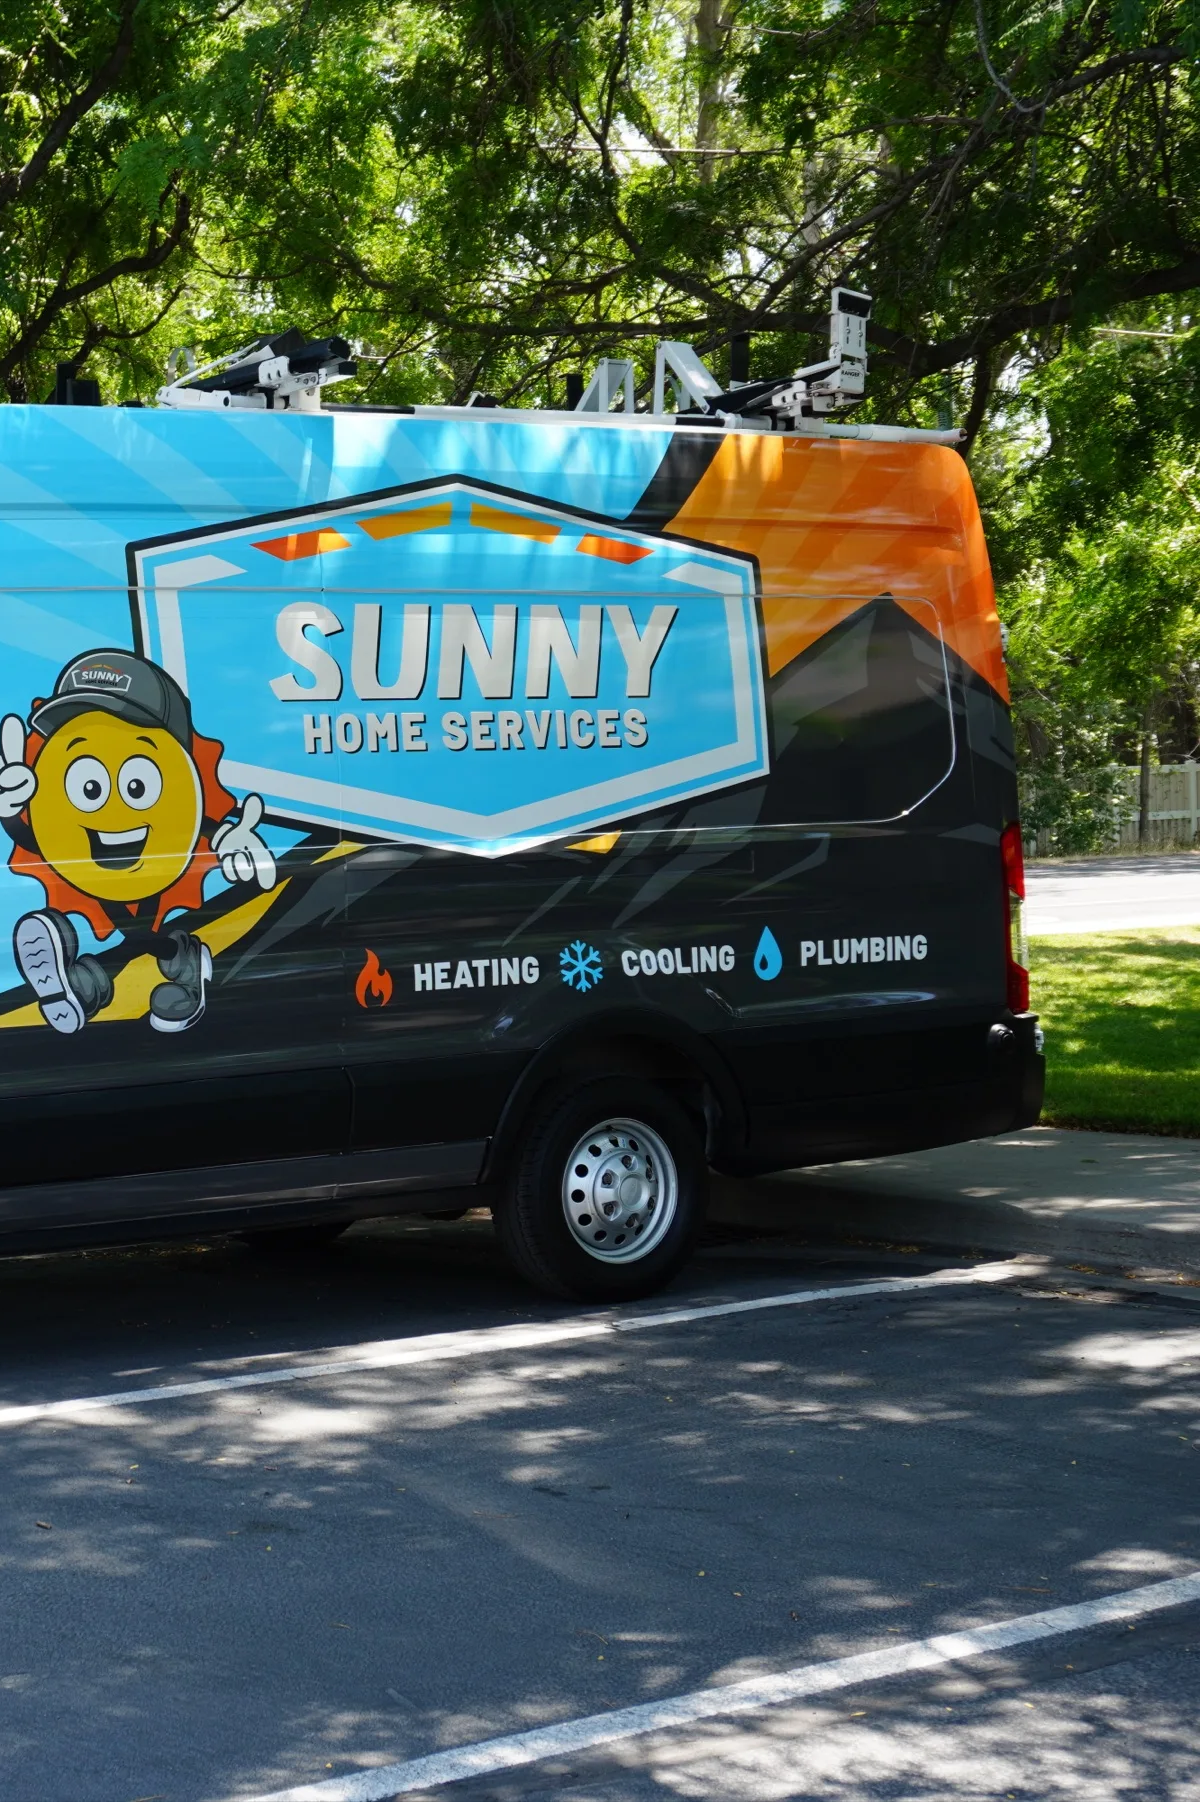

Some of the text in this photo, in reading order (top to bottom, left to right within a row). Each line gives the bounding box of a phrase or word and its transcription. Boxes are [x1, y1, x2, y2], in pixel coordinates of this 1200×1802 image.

[81, 671, 123, 683] SUNNY
[269, 601, 679, 702] SUNNY
[302, 708, 650, 754] HOME SERVICES
[413, 934, 928, 992] HEATING COOLING PLUMBING
